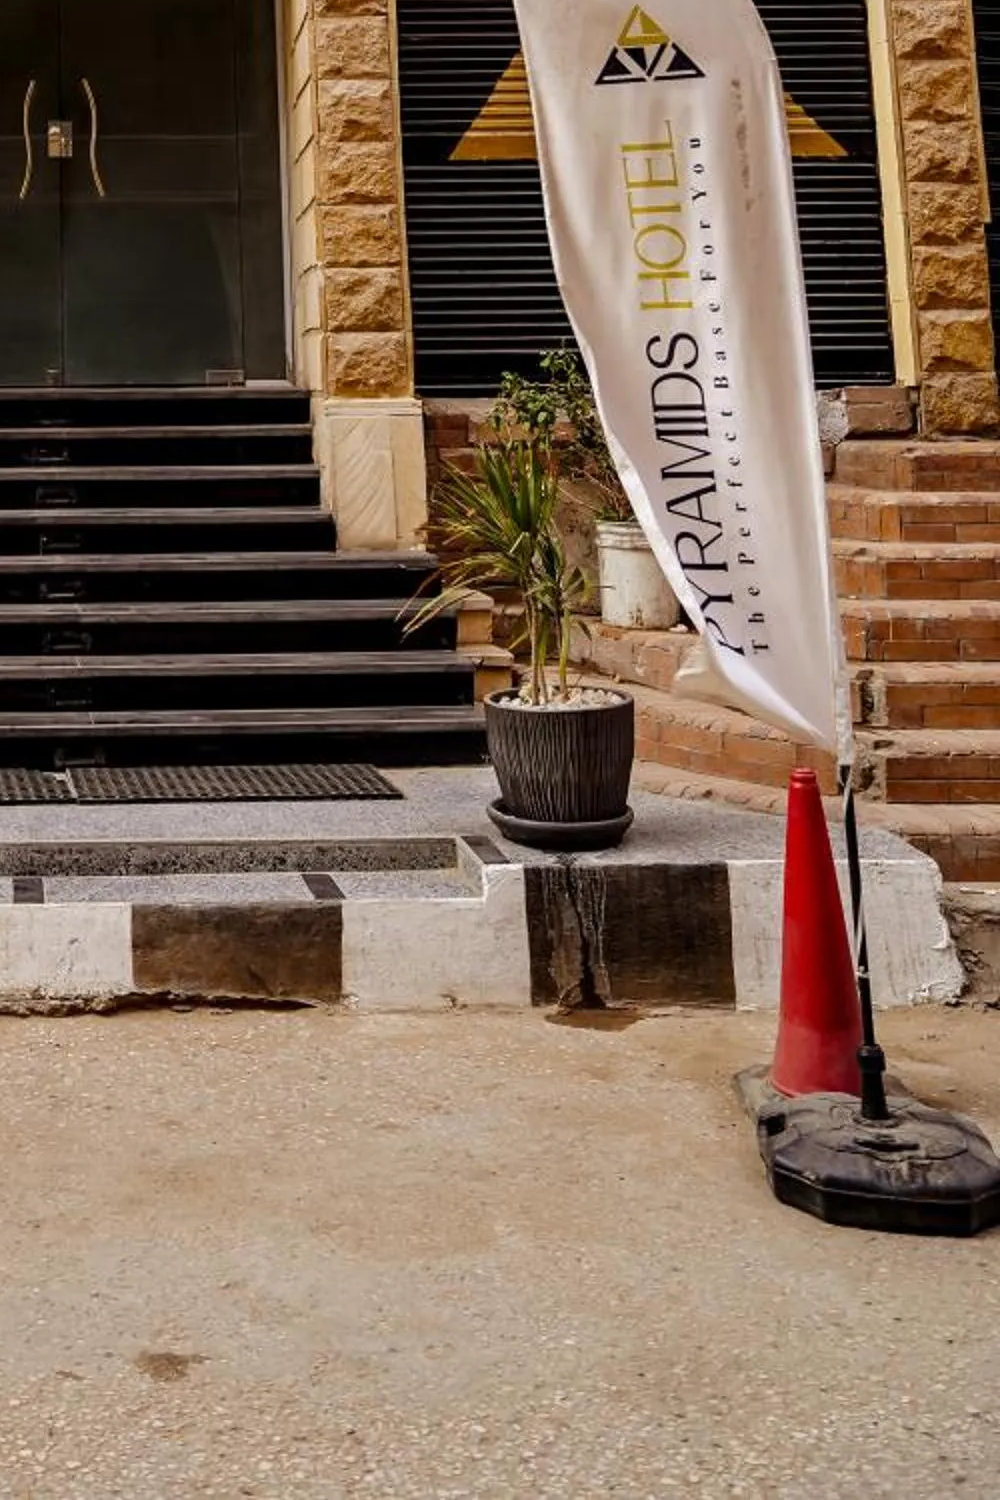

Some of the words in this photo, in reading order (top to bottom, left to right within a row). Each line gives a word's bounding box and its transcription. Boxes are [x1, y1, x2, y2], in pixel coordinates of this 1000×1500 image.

[689, 137, 707, 204] You
[620, 120, 693, 309] HOTEL
[700, 219, 717, 282] For
[710, 303, 729, 389] Base
[645, 332, 745, 656] PYRAMIDS
[720, 410, 755, 565] Perfect
[748, 586, 769, 654] The
